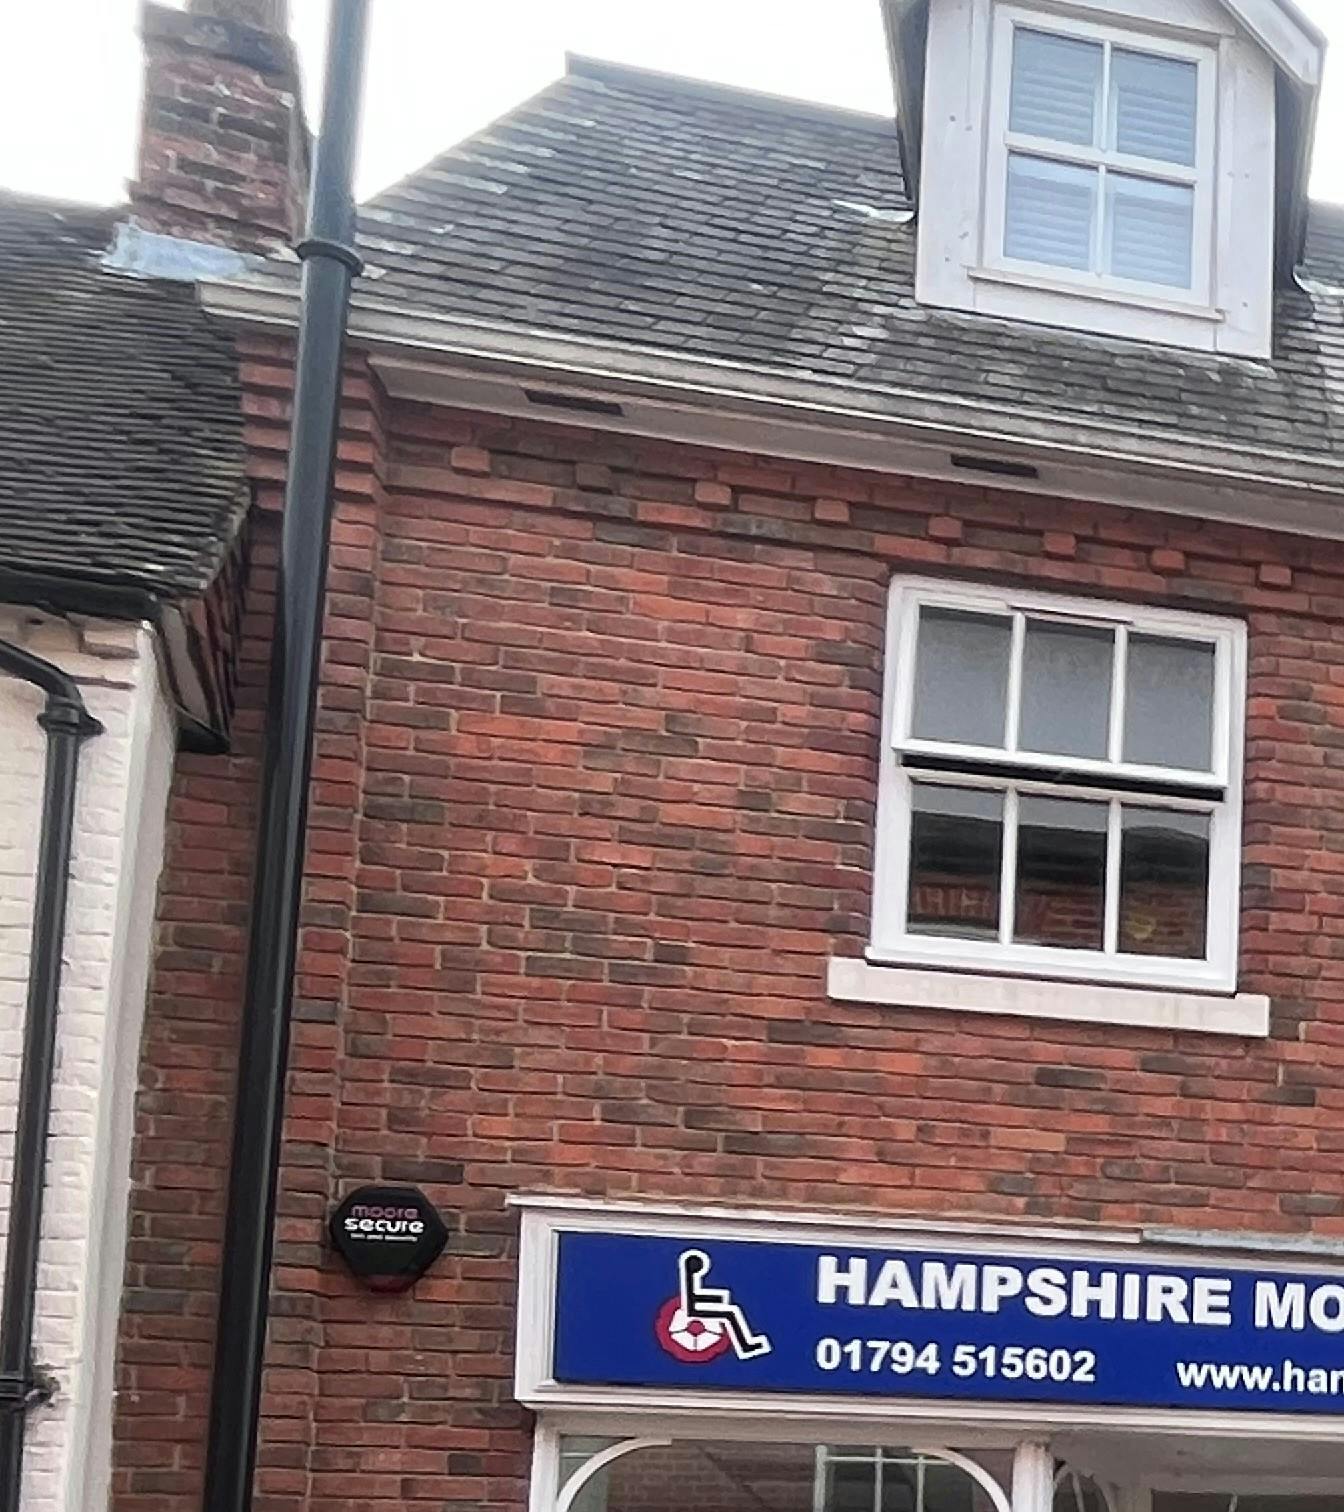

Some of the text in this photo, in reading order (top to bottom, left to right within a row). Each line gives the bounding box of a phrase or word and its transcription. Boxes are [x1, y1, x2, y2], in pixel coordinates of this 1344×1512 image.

[344, 1218, 424, 1234] secure
[816, 1254, 1233, 1326] HAMPSHIRE
[816, 1338, 941, 1376] 01794
[952, 1344, 1097, 1383] 515602
